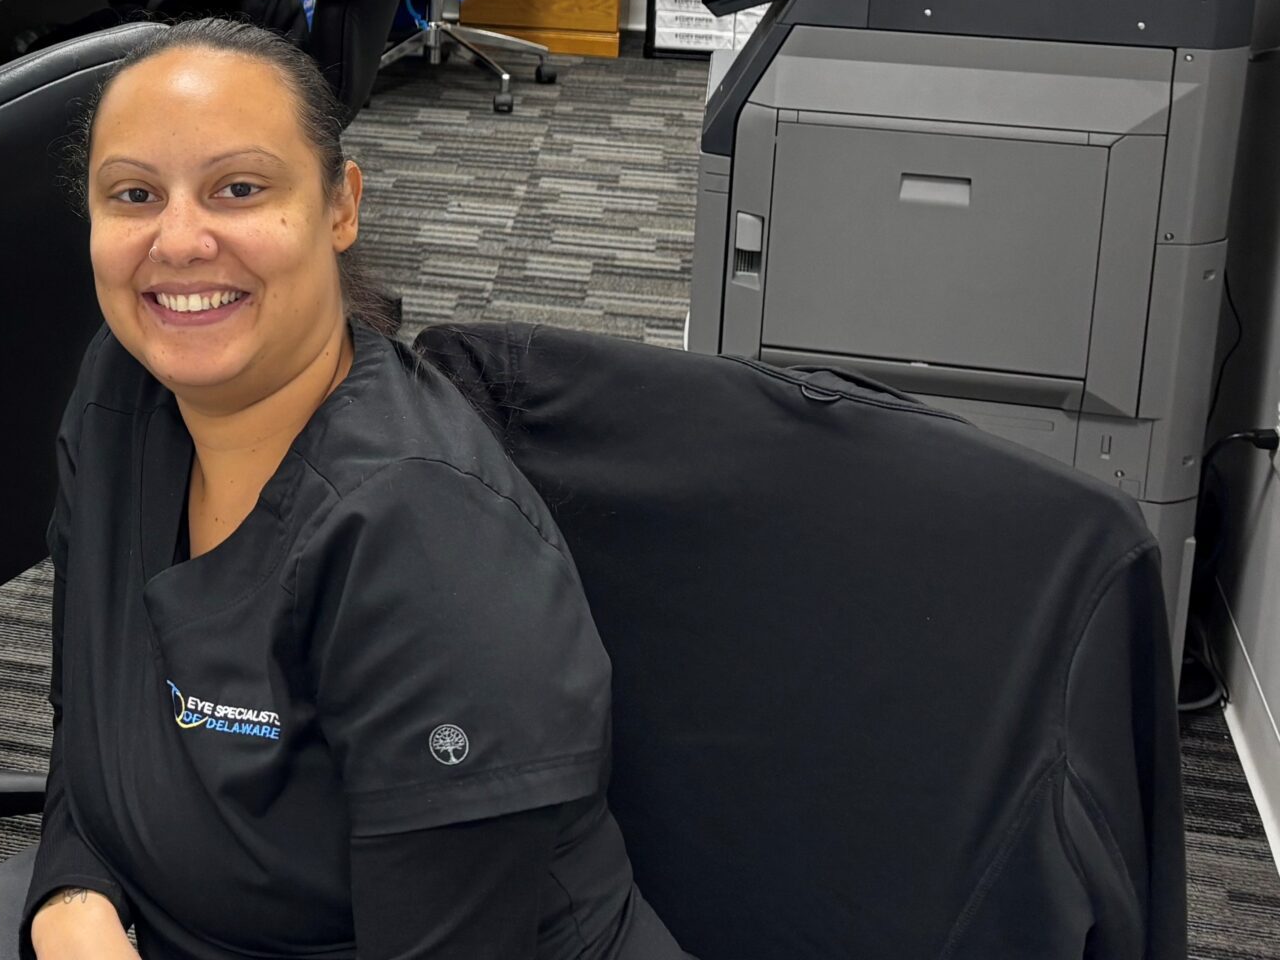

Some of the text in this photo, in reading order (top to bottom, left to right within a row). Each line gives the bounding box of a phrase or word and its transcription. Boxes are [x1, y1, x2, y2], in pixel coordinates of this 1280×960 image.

[187, 696, 214, 715] EYE
[183, 711, 280, 739] OF DELAWARE
